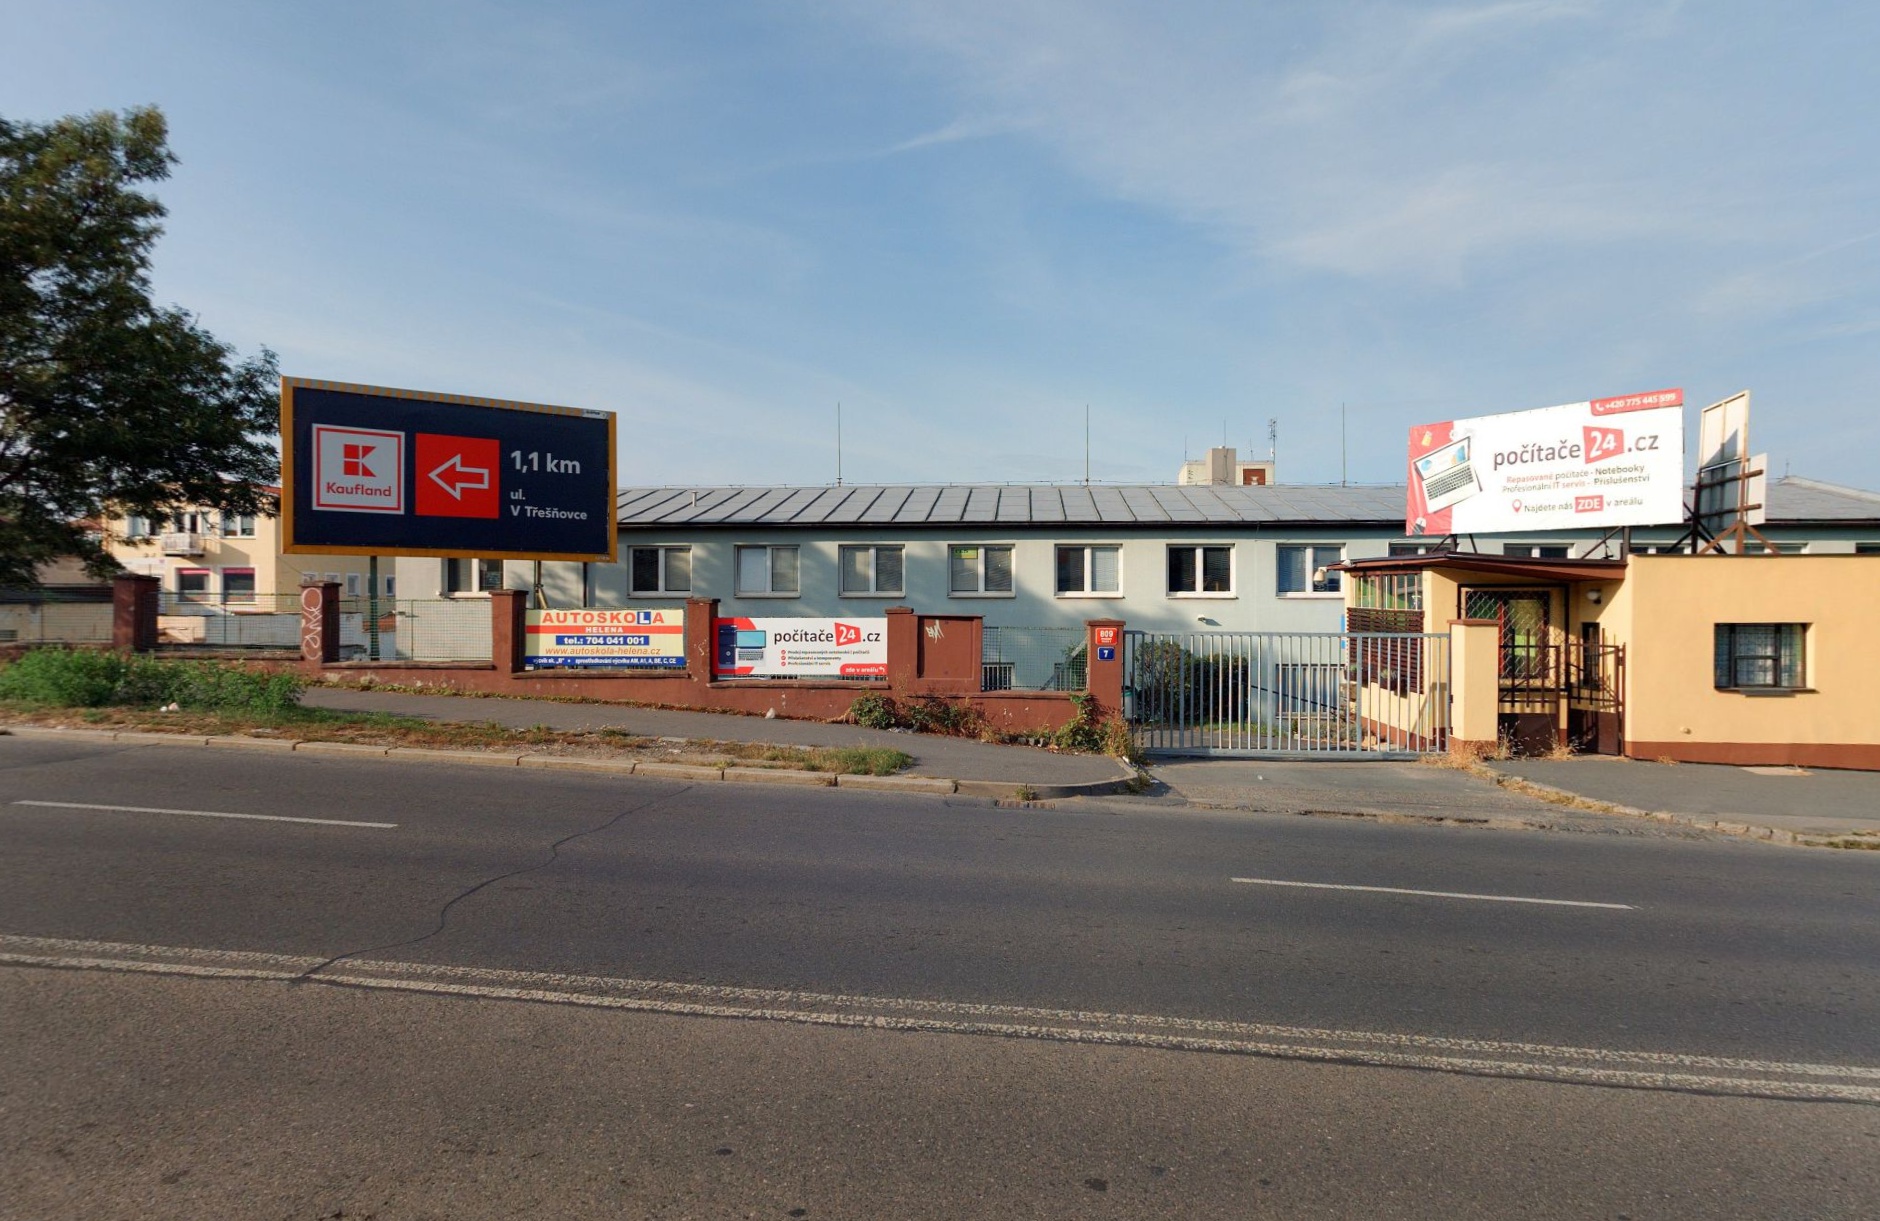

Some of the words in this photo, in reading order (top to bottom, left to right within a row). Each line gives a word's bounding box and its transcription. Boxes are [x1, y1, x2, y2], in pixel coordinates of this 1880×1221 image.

[1625, 398, 1641, 407] 775
[1642, 395, 1658, 404] 445
[510, 450, 539, 474] 1,1
[546, 453, 581, 474] km
[1595, 464, 1645, 475] Notebooky
[326, 482, 392, 497] Kaufland
[510, 488, 526, 500] ul.
[1577, 498, 1601, 511] ZDE
[1614, 497, 1643, 507] areálu
[510, 505, 521, 517] V
[524, 505, 588, 520] Třešňovce
[542, 611, 665, 624] AUTOSKOLA
[564, 636, 584, 645] tel.:
[586, 636, 604, 645] 704
[606, 636, 624, 645] 041
[626, 636, 645, 645] 001
[545, 646, 661, 655] www.autoskola-helena.cz
[1103, 650, 1108, 658] 7
